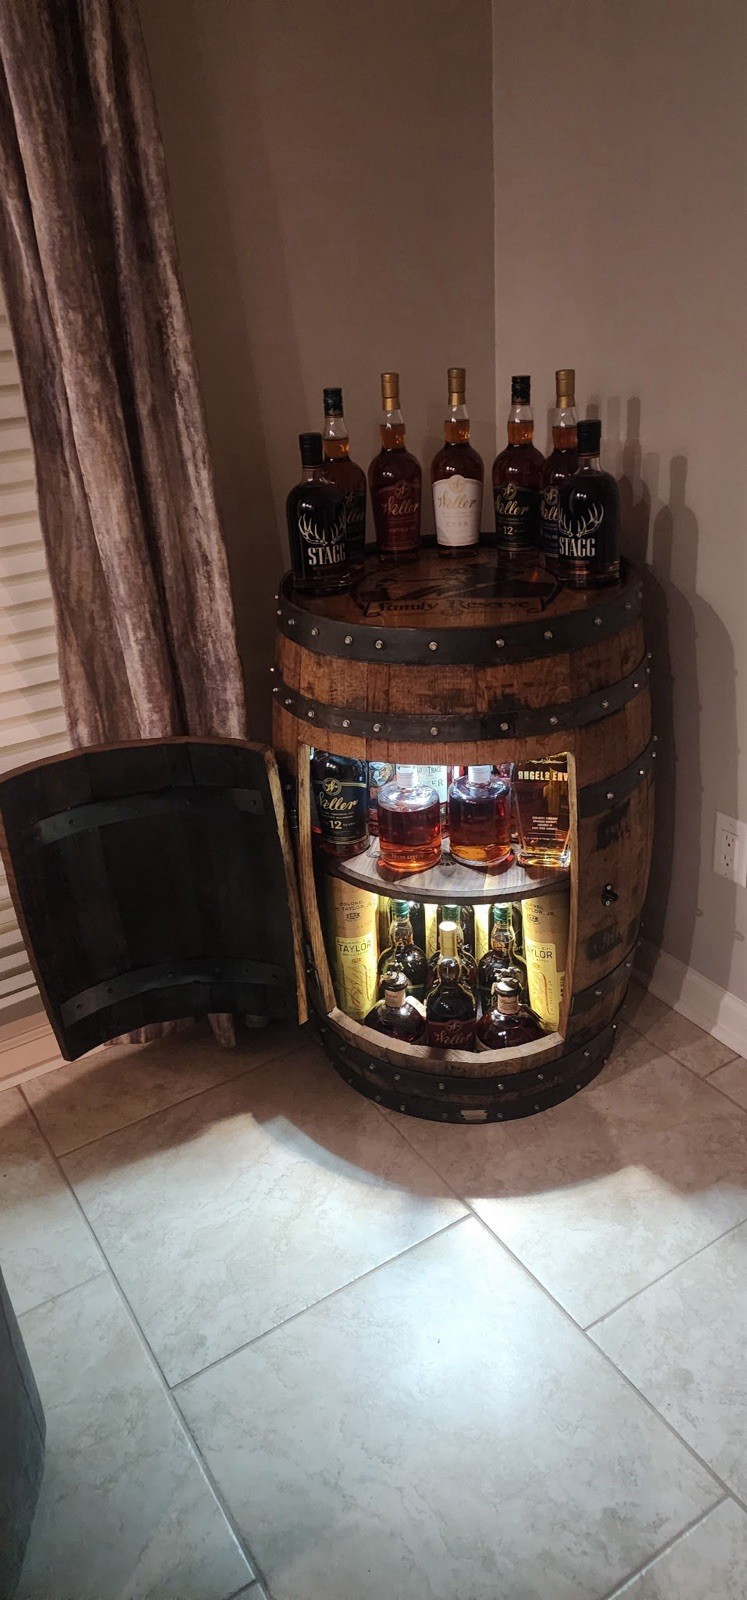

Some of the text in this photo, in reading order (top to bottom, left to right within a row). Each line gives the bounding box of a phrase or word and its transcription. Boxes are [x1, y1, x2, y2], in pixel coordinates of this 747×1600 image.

[382, 495, 420, 516] Weller
[437, 490, 477, 509] Weller
[502, 526, 514, 535] 12
[308, 543, 346, 566] STAGG
[559, 537, 596, 557] STAGG
[328, 820, 343, 830] 12
[337, 940, 372, 953] TAYLOR
